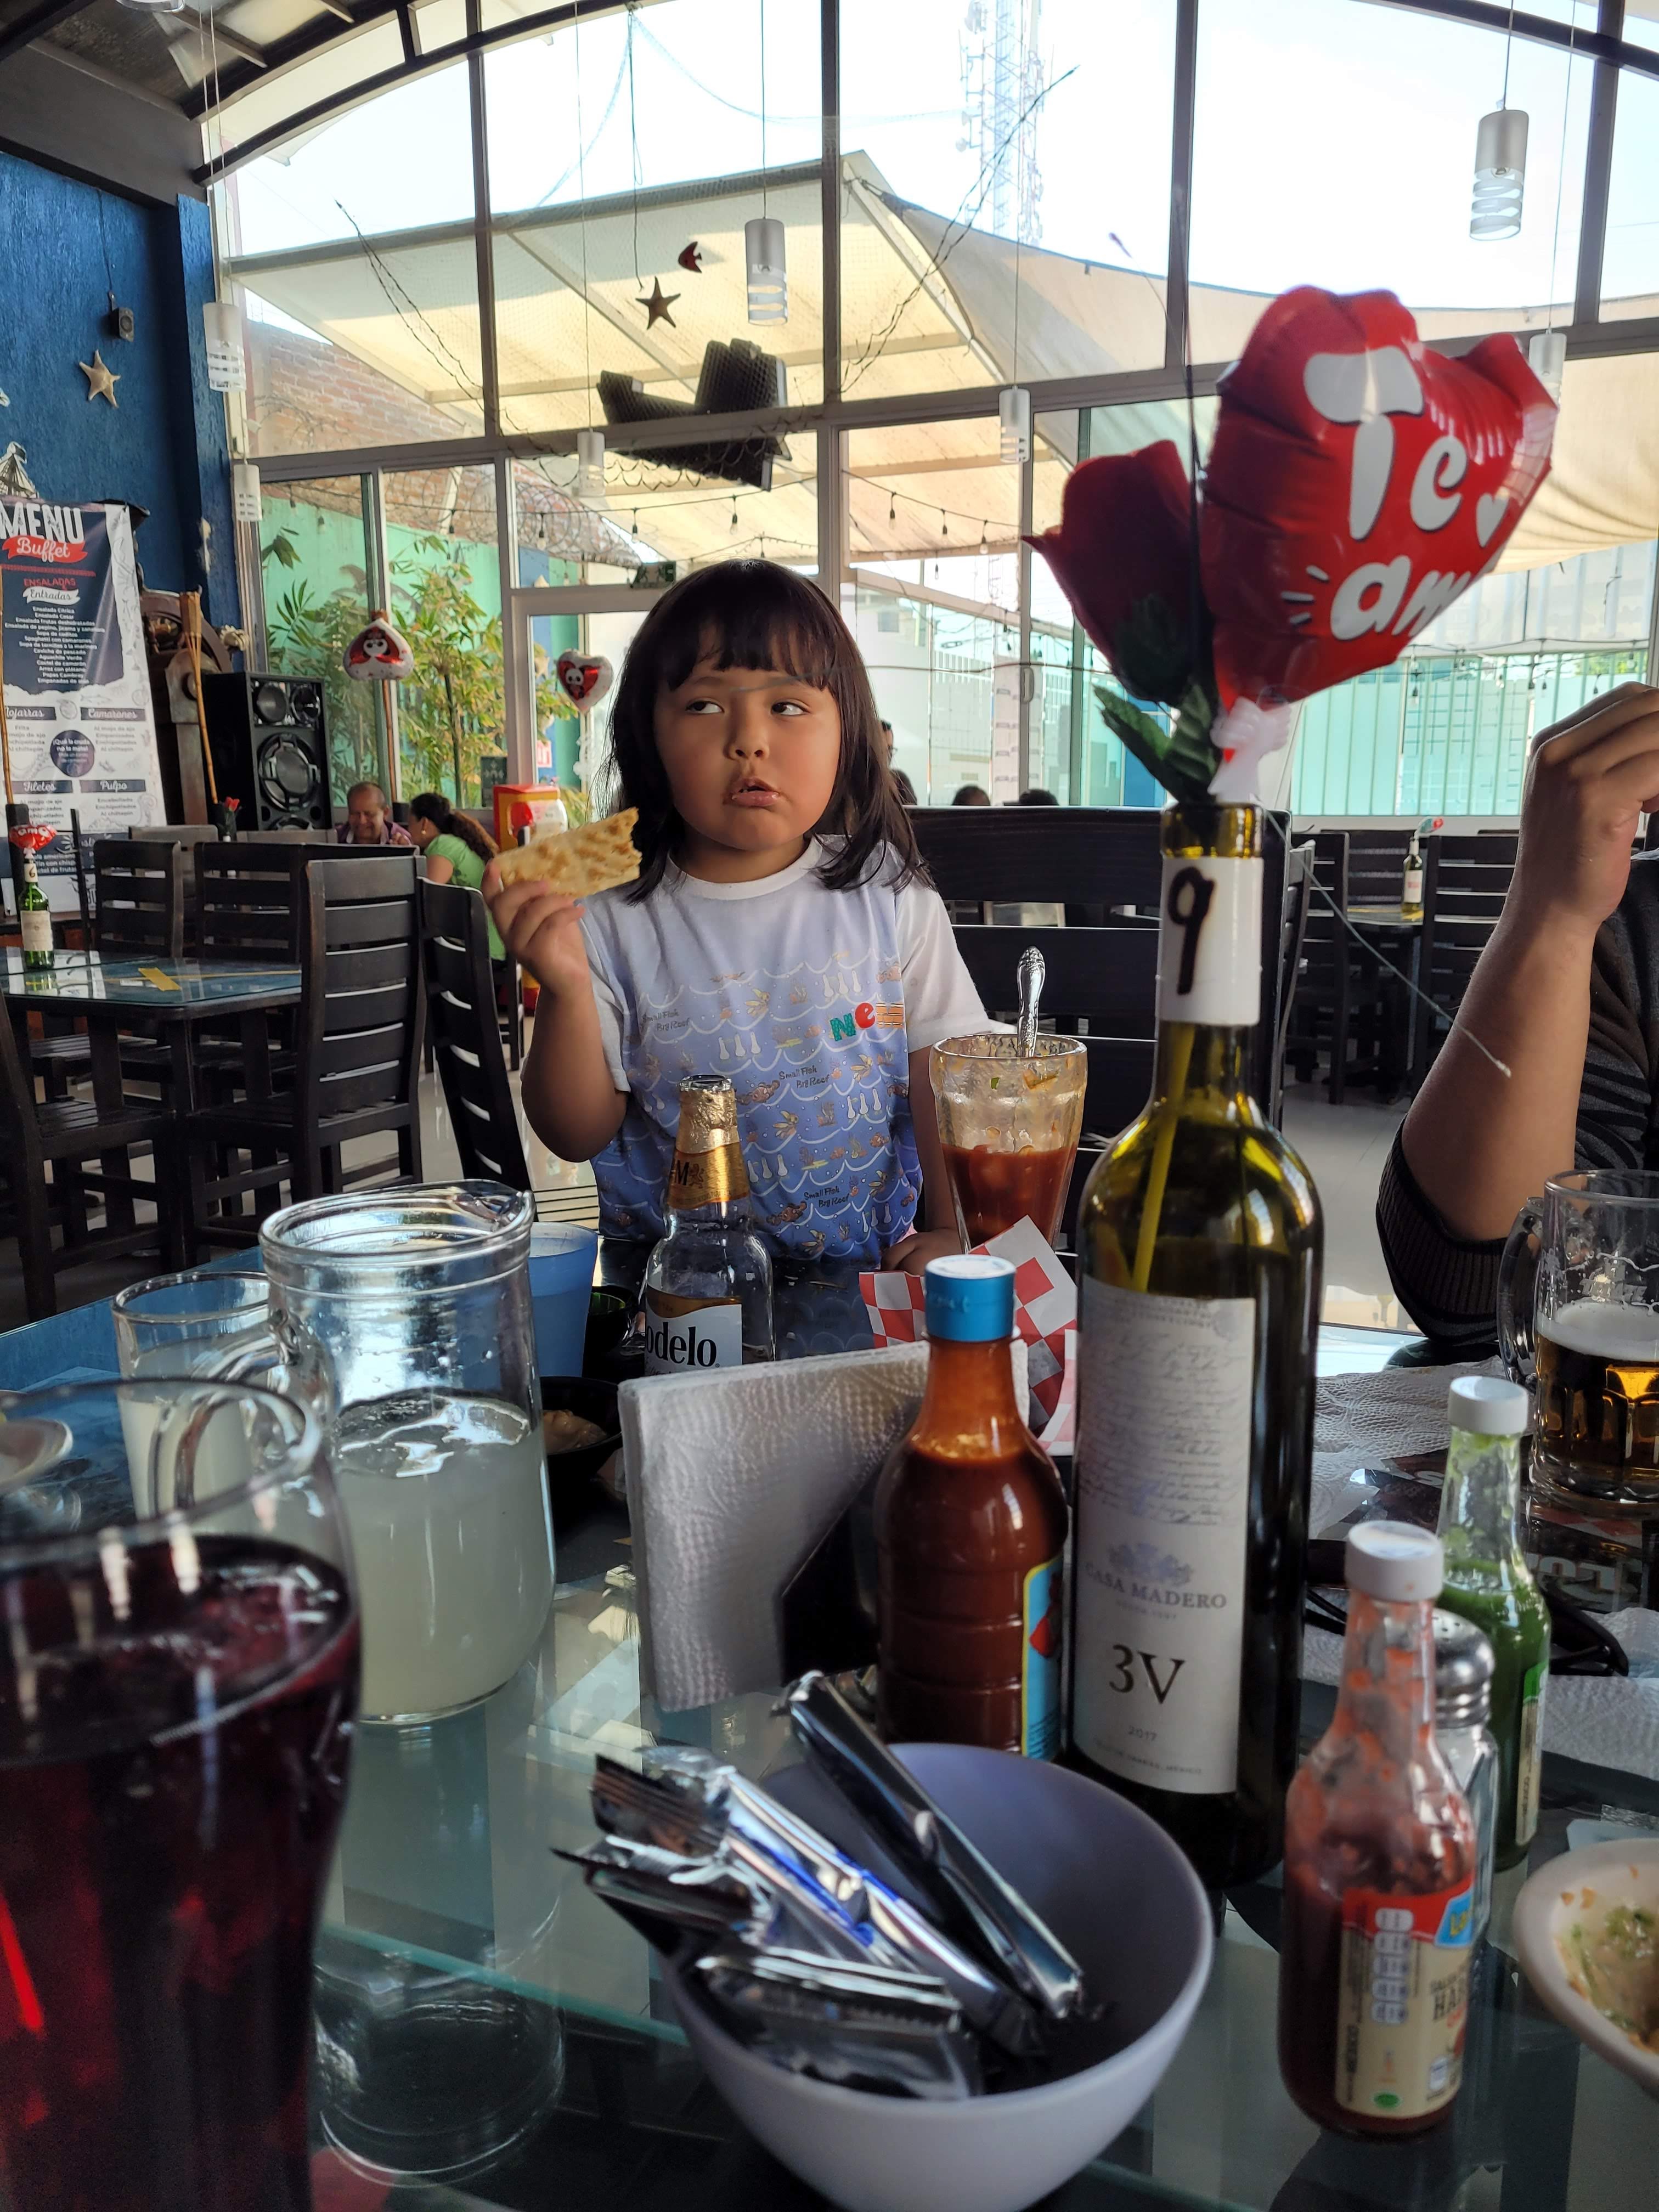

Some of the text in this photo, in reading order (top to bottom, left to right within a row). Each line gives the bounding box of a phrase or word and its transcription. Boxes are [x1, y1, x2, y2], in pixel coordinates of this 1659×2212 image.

[1304, 345, 1469, 540] Te
[0, 500, 84, 544] MENU
[16, 537, 70, 563] Buffet
[30, 589, 71, 600] Entradas
[1330, 555, 1476, 641] am
[6, 707, 45, 719] ojarras
[88, 708, 138, 719] Camarones
[24, 781, 57, 792] Filetes
[100, 780, 128, 792] Pulpo
[29, 867, 36, 878] 6
[1167, 867, 1216, 995] 9
[662, 1009, 679, 1018] Fish
[657, 1017, 690, 1031] Big Reef
[778, 1064, 817, 1080] Small Fish
[796, 1074, 830, 1088] Big Reef
[804, 1185, 840, 1200] Small Fish
[818, 1193, 849, 1207] Big Reef
[646, 1321, 717, 1367] odelo
[1132, 1582, 1228, 1609] MADERO
[1109, 1644, 1186, 1705] 3V
[1128, 1726, 1158, 1741] 2017
